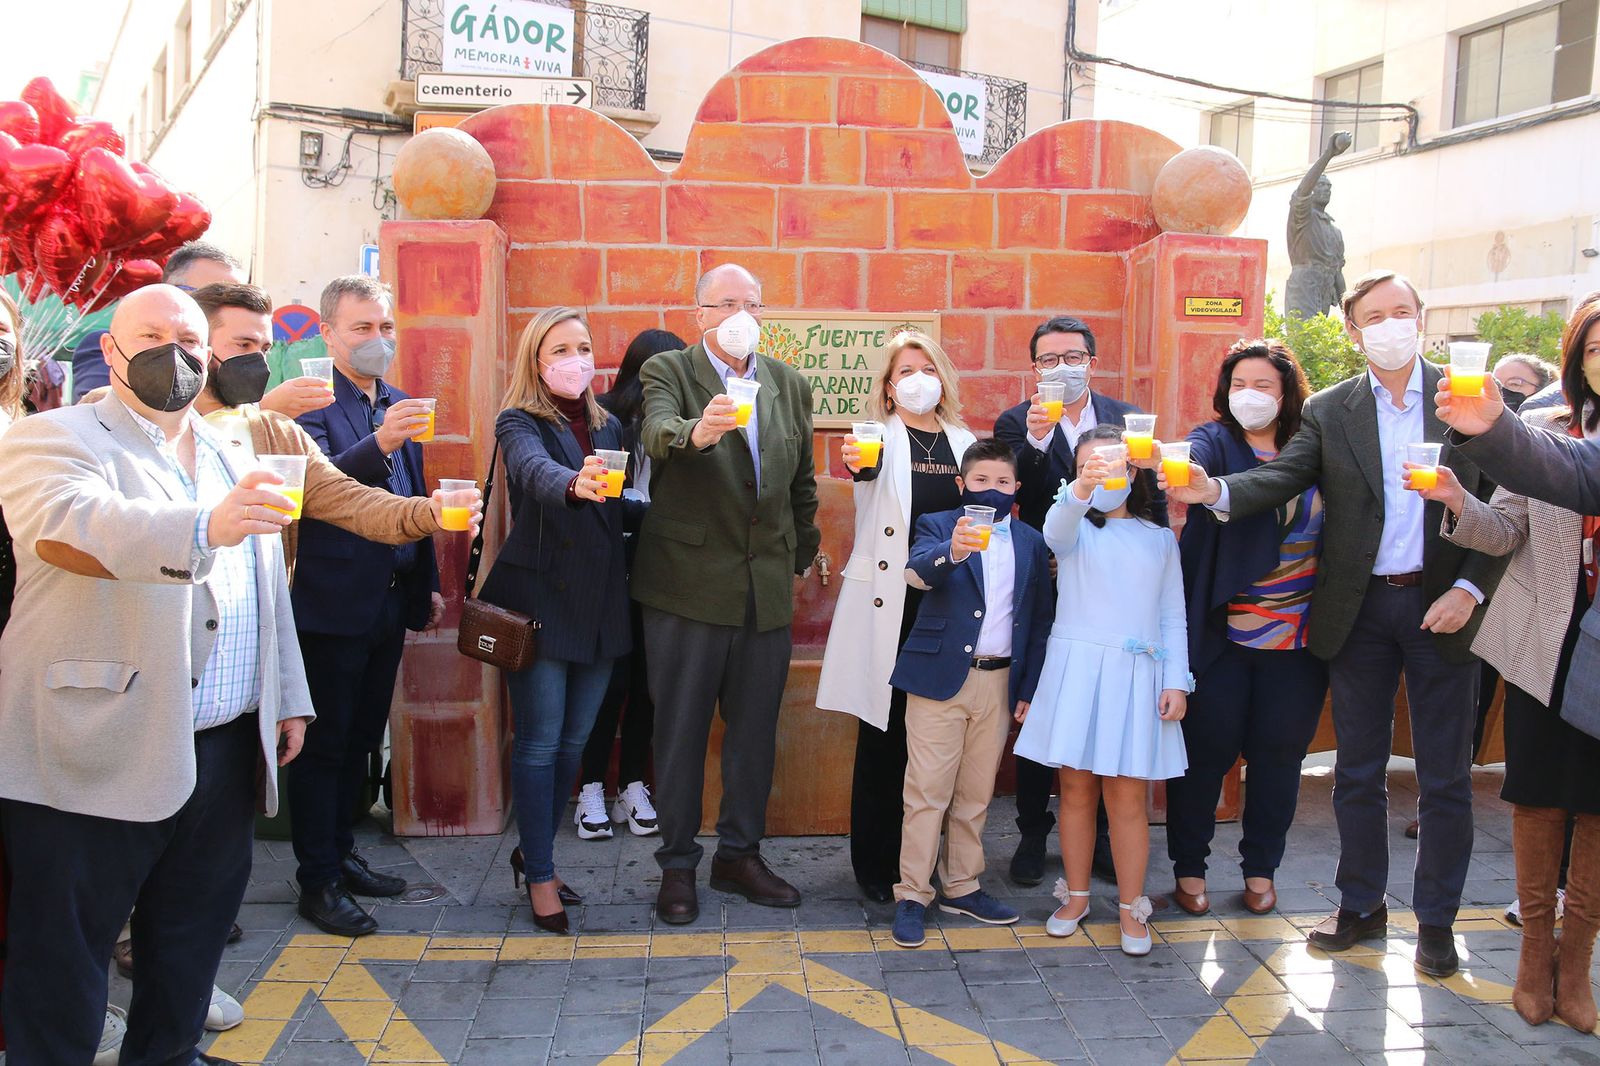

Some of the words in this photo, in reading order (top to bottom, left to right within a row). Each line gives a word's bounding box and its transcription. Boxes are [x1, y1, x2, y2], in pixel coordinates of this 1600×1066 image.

[450, 4, 566, 53] GÁDOR
[454, 48, 521, 67] MEMORIA
[534, 59, 562, 74] VIVA
[422, 83, 512, 97] cementerio
[805, 324, 885, 349] FUENTE
[803, 353, 829, 369] DE
[841, 353, 868, 370] LA
[837, 397, 860, 415] DE
